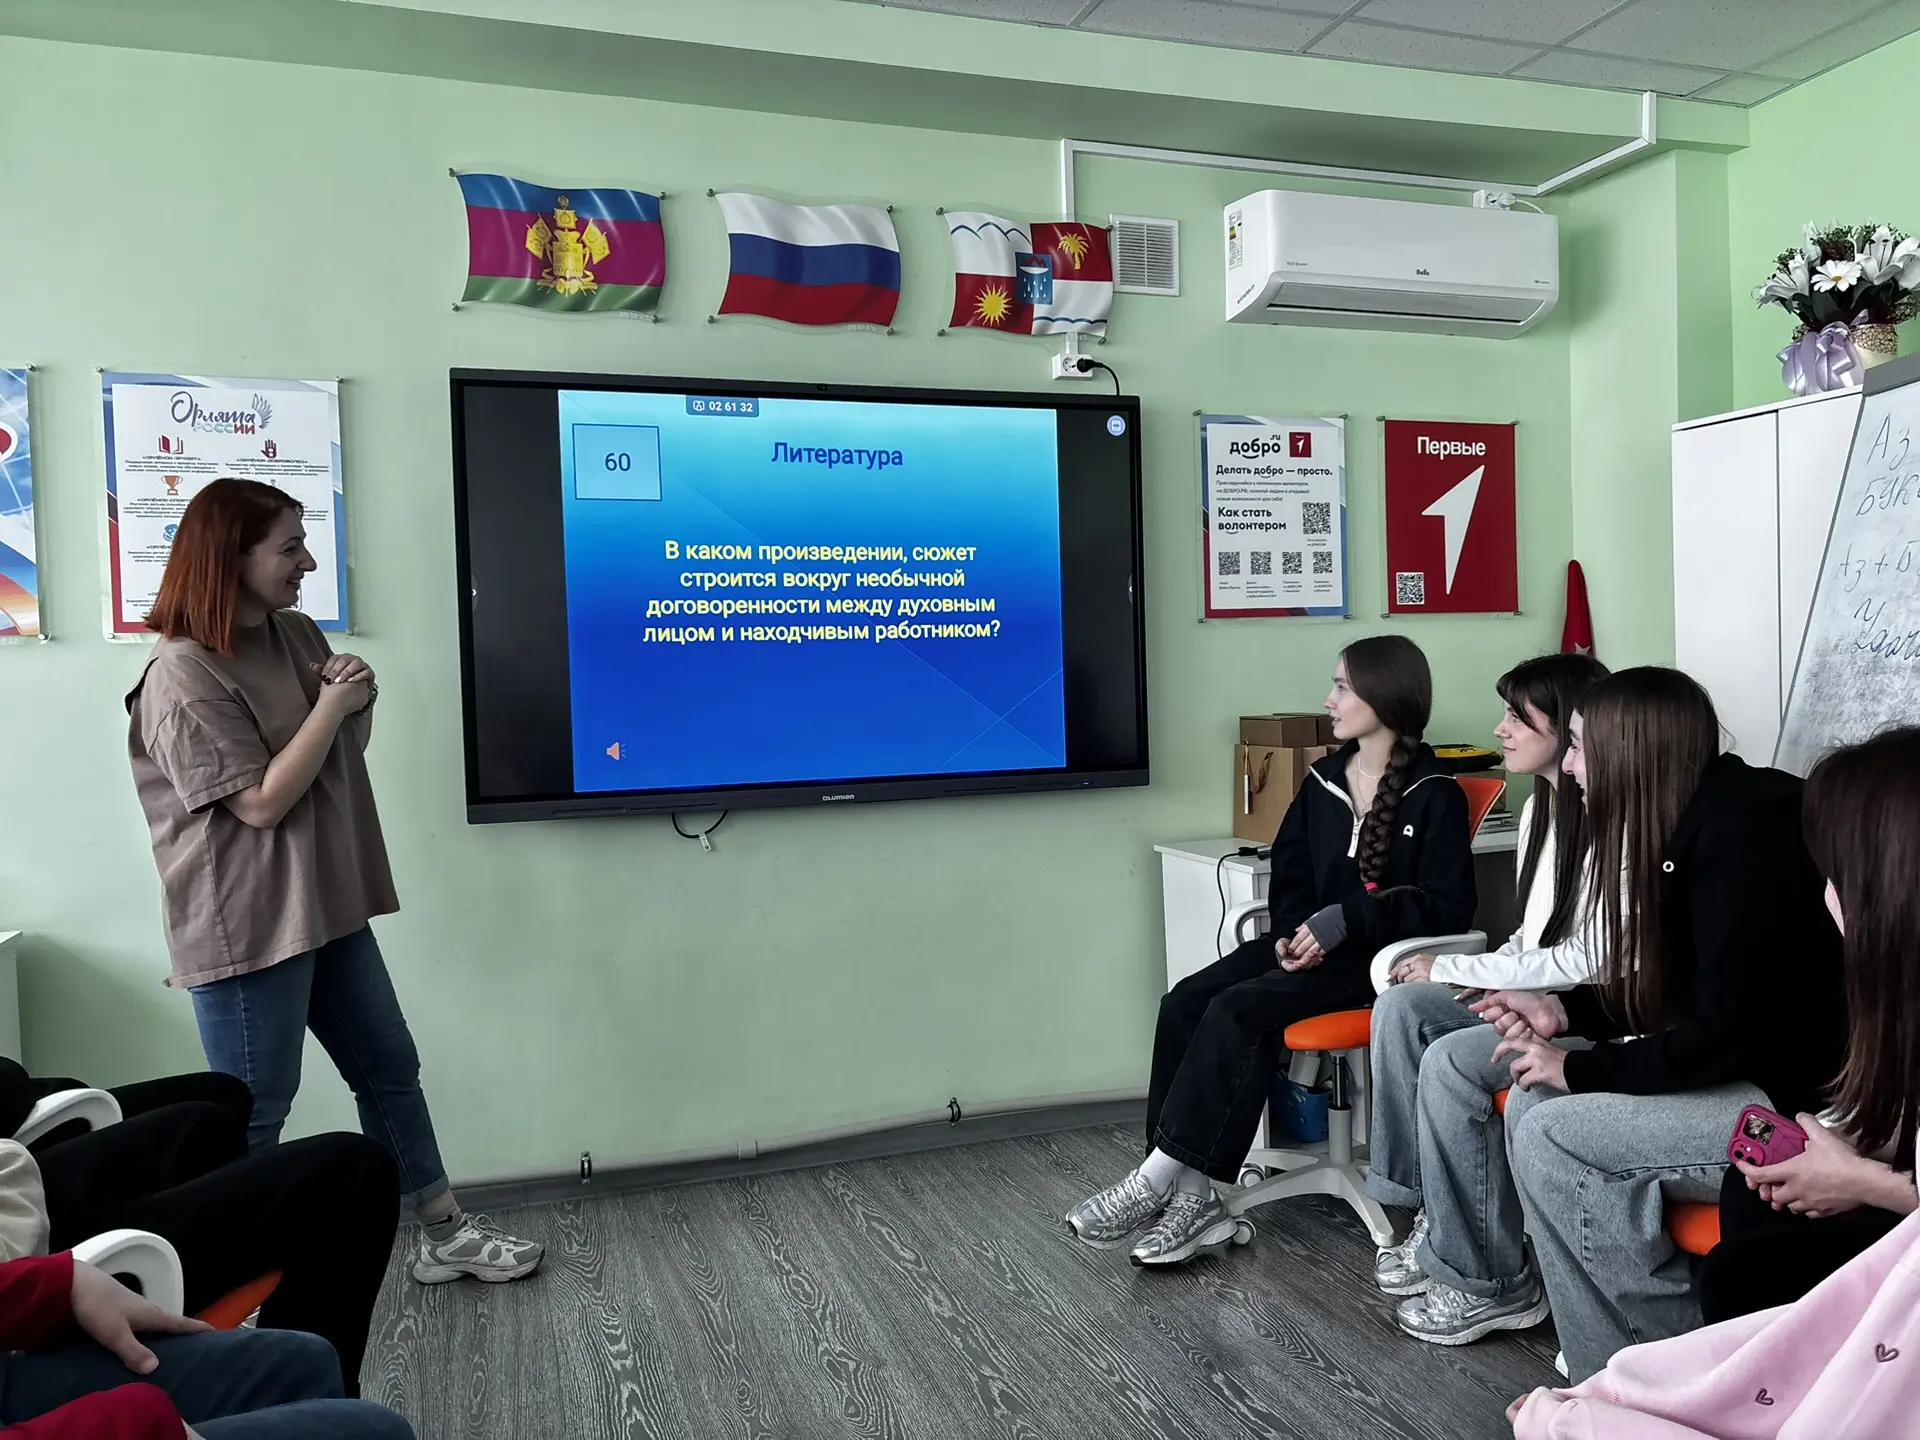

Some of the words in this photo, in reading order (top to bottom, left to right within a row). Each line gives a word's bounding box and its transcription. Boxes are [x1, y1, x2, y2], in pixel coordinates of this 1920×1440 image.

[170, 391, 256, 427] Орлята
[709, 401, 722, 411] 02
[724, 402, 737, 411] 61
[740, 403, 753, 412] 32
[771, 442, 904, 470] Литература
[1229, 438, 1281, 458] добро
[1417, 436, 1486, 460] Первые
[605, 453, 631, 472] 60
[1216, 465, 1252, 475] Делать
[1254, 465, 1284, 477] добро
[1297, 468, 1333, 477] просто.
[1218, 507, 1239, 517] Как
[1242, 509, 1272, 517] стать
[1218, 522, 1287, 533] волонтером
[665, 541, 680, 559] В
[686, 545, 752, 560] каком
[758, 546, 908, 564] произведении,
[912, 546, 977, 560] сюжет
[680, 573, 777, 592] строится
[783, 572, 852, 591] вокруг
[856, 568, 965, 587] необычной
[646, 598, 821, 618] договоренности
[826, 599, 892, 617] между
[897, 598, 996, 617] духовным
[643, 626, 715, 645] лицом
[721, 627, 734, 641] и
[740, 625, 869, 644] находчивым
[875, 619, 1001, 644] работником?
